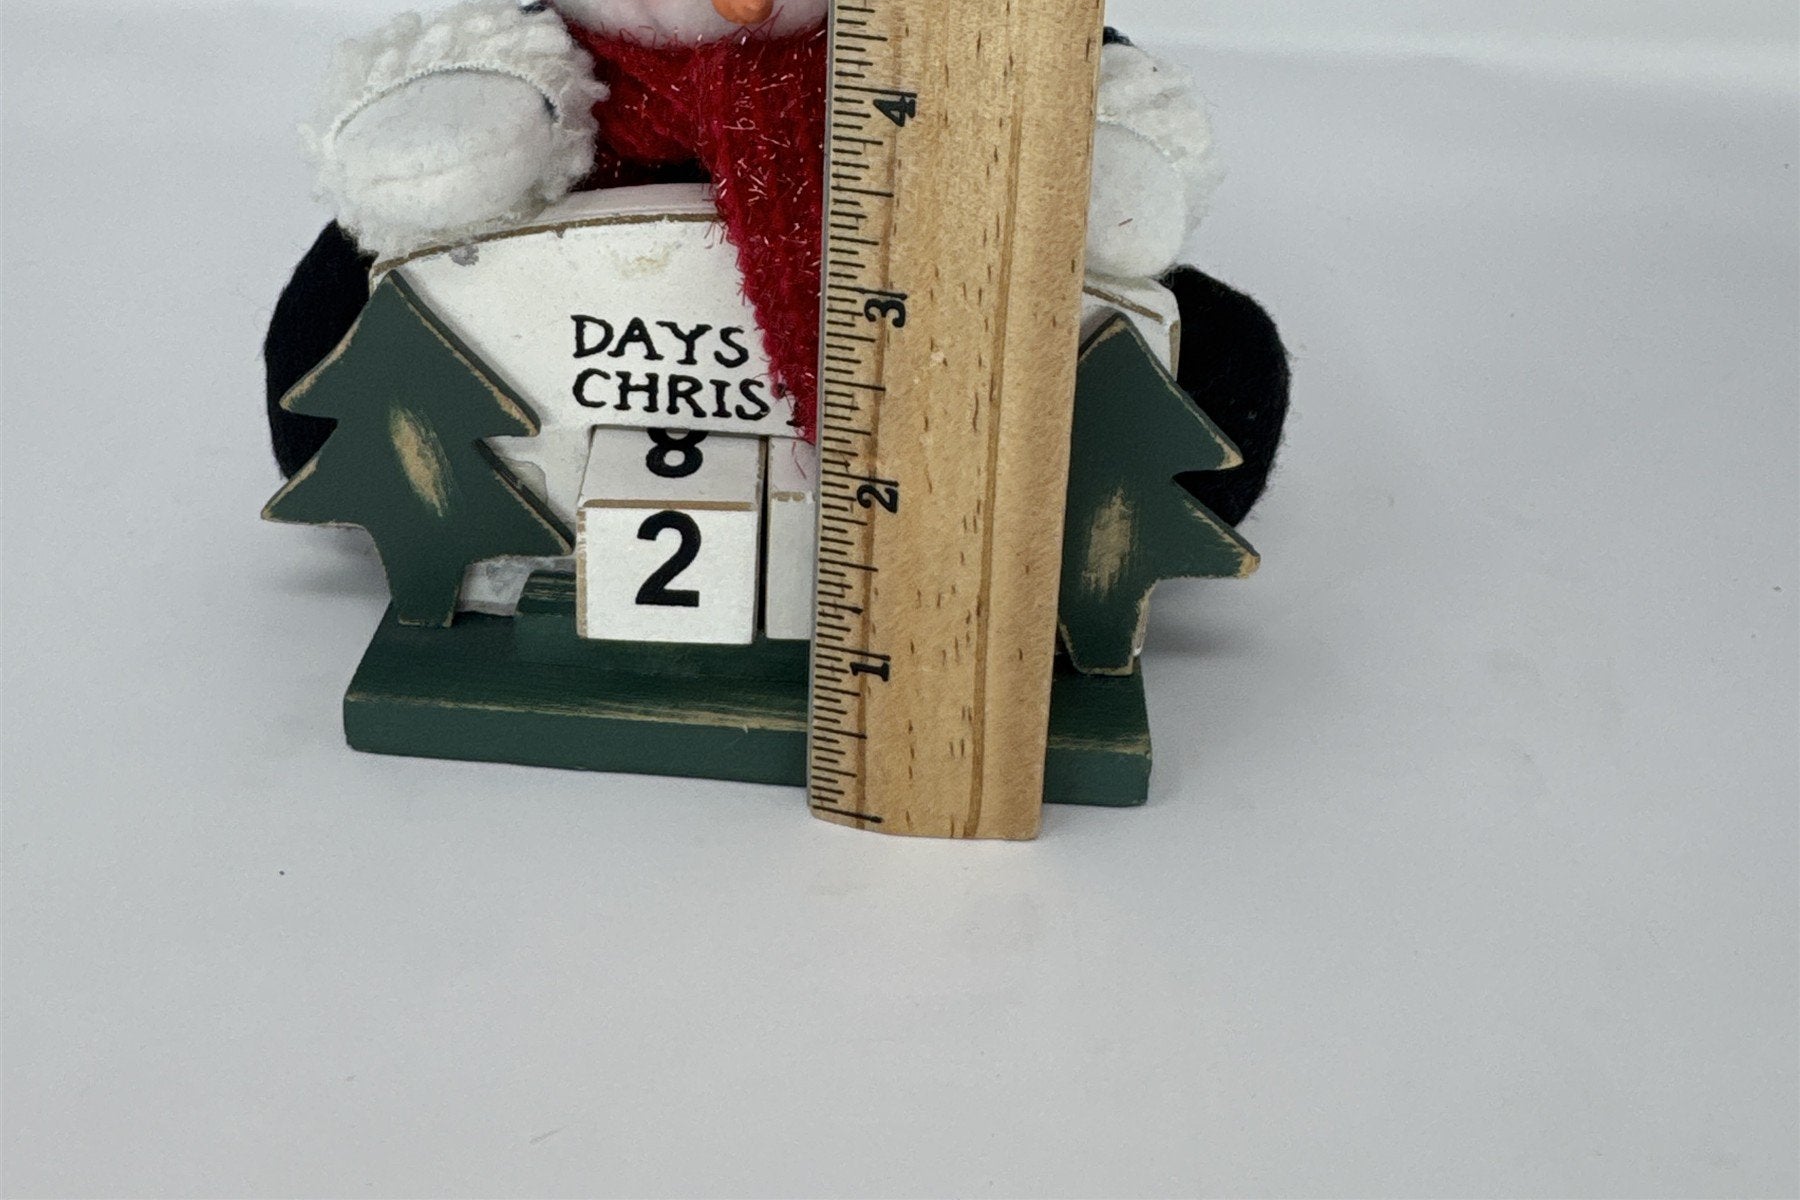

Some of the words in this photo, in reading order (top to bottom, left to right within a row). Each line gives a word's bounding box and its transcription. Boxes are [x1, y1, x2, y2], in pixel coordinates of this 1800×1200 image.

[873, 97, 917, 127] 4
[864, 298, 907, 328] 3
[570, 314, 750, 369] DAYS
[856, 484, 899, 514] 2
[634, 509, 702, 608] 2
[849, 659, 892, 682] 1
